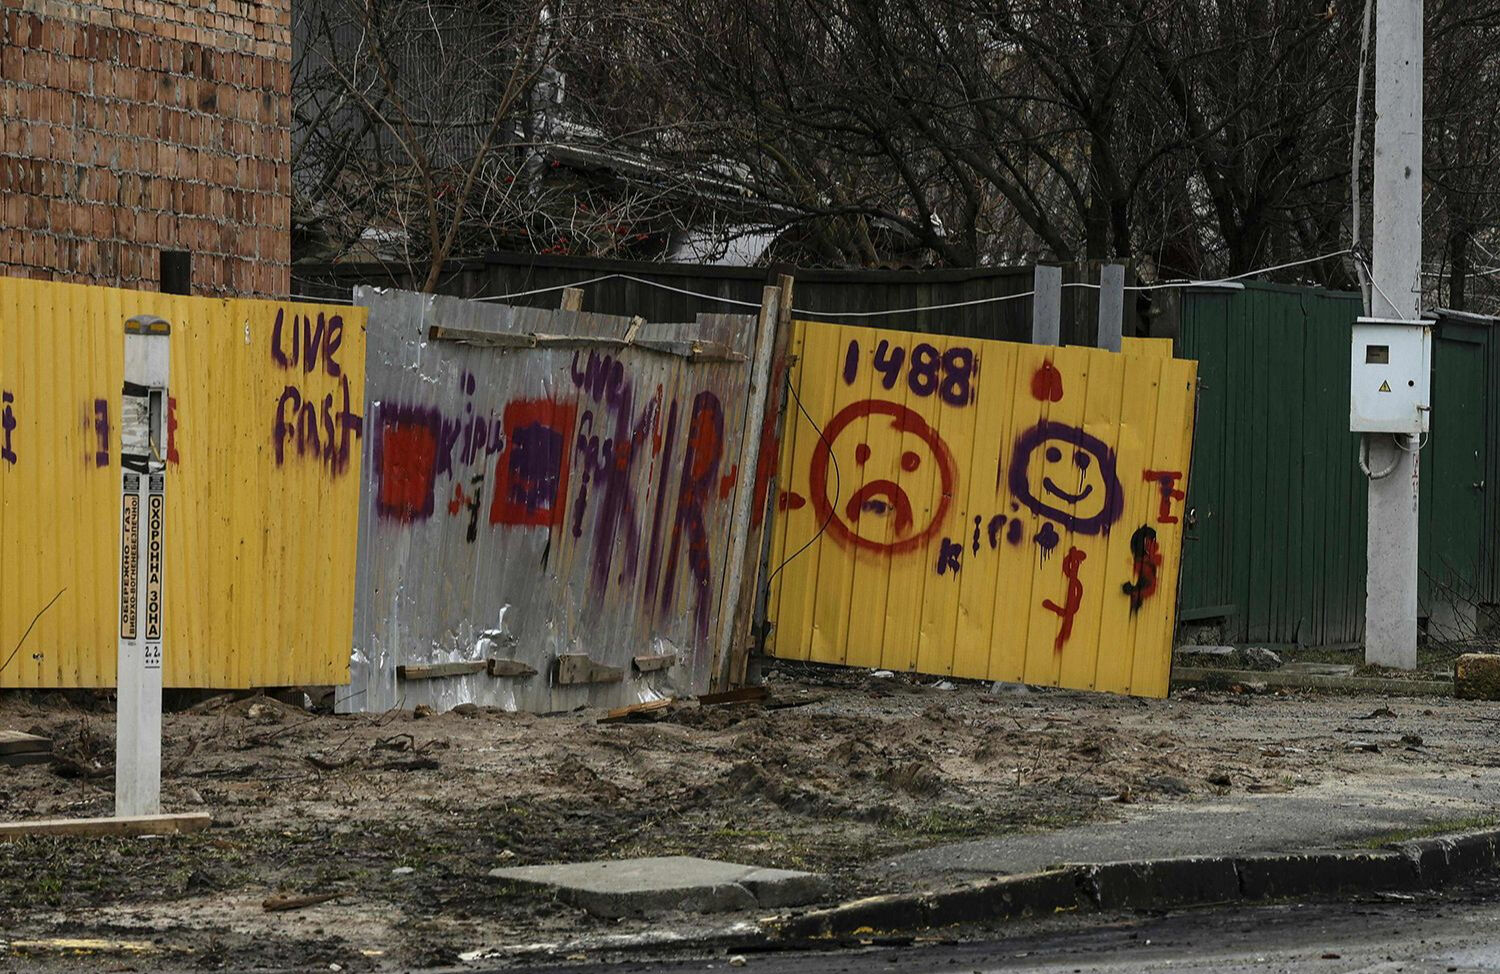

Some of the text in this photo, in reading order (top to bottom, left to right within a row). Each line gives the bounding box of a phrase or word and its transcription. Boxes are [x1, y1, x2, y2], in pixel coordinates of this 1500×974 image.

[843, 339, 979, 408] 1488
[150, 497, 161, 584] ОХОРОННА
[122, 545, 130, 624] ОБЕРЕЖНО
[148, 590, 158, 636] ЗОНА
